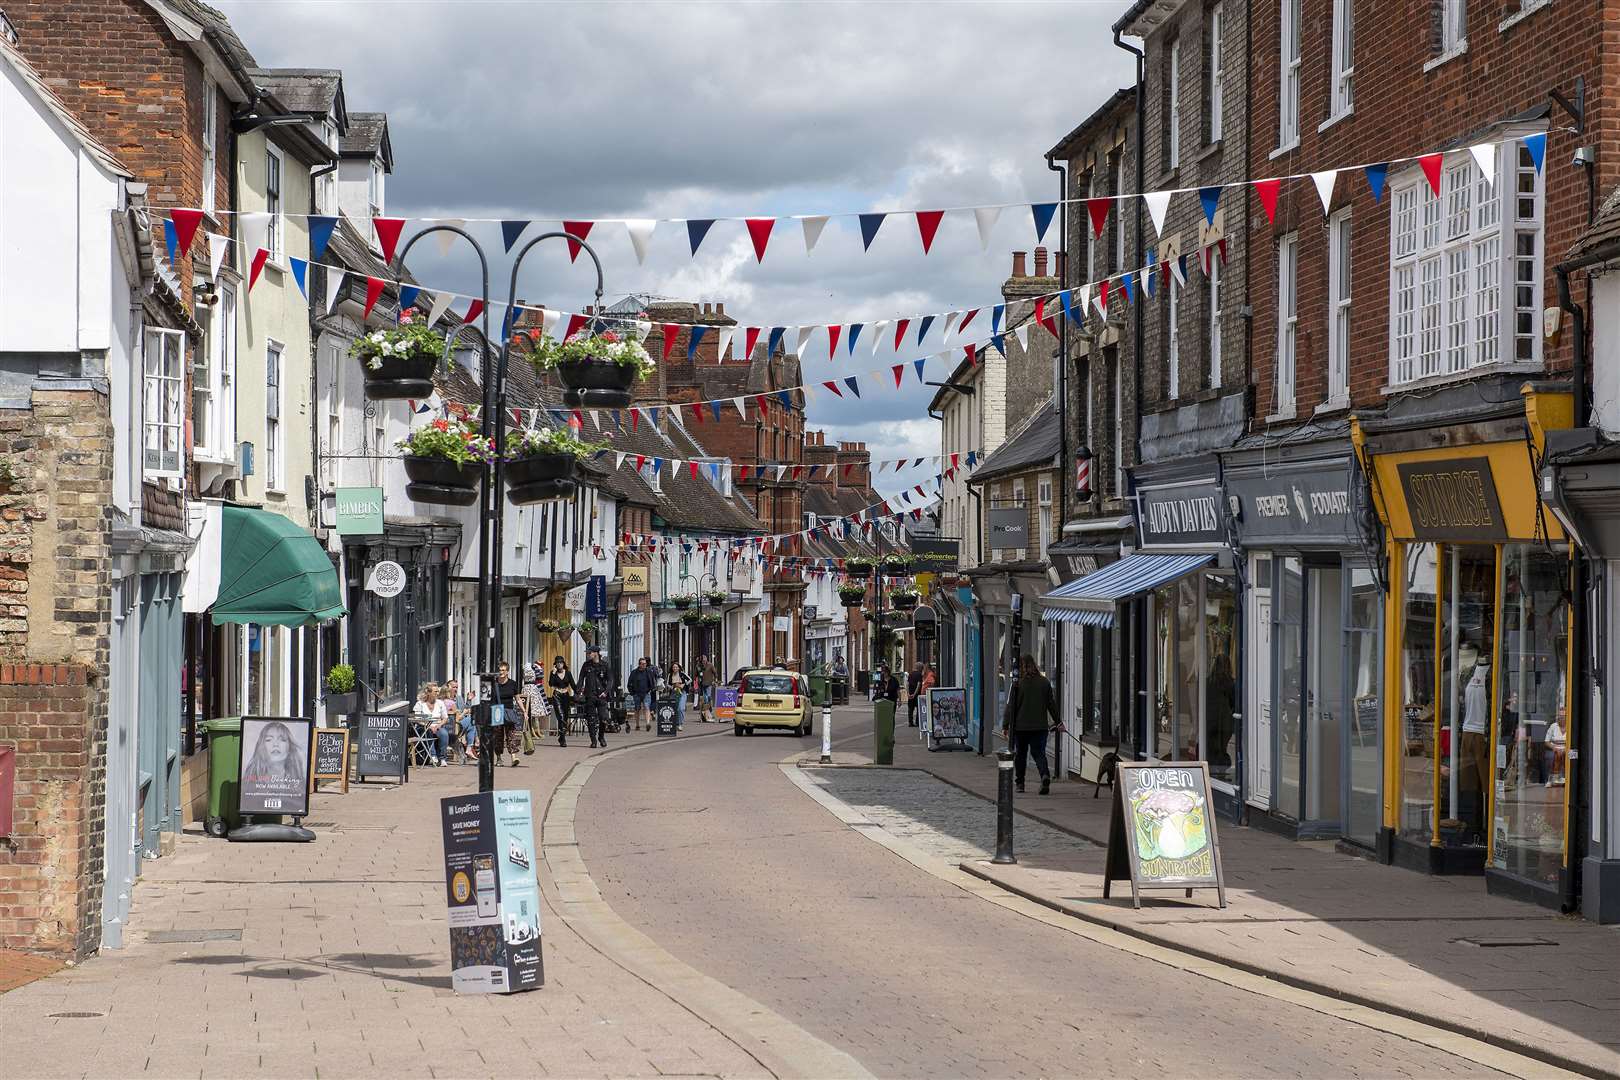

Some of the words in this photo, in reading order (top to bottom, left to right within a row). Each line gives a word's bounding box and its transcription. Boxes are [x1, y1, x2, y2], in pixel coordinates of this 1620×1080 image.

[1255, 494, 1290, 518] PREMIER
[1310, 491, 1350, 515] PODIATR
[1409, 470, 1493, 528] SUNRISE
[339, 500, 380, 515] BIMBO'S
[1149, 500, 1181, 534] AUBYN
[1178, 496, 1217, 533] DAVIES
[993, 524, 1022, 533] ProCook
[367, 717, 401, 728] BIMBO'S
[376, 731, 388, 740] MY
[364, 738, 381, 747] HAIR
[388, 738, 398, 748] IS
[454, 804, 480, 815] LoyalFree
[463, 820, 480, 828] MONEY
[1140, 849, 1212, 878] SUNRISE
